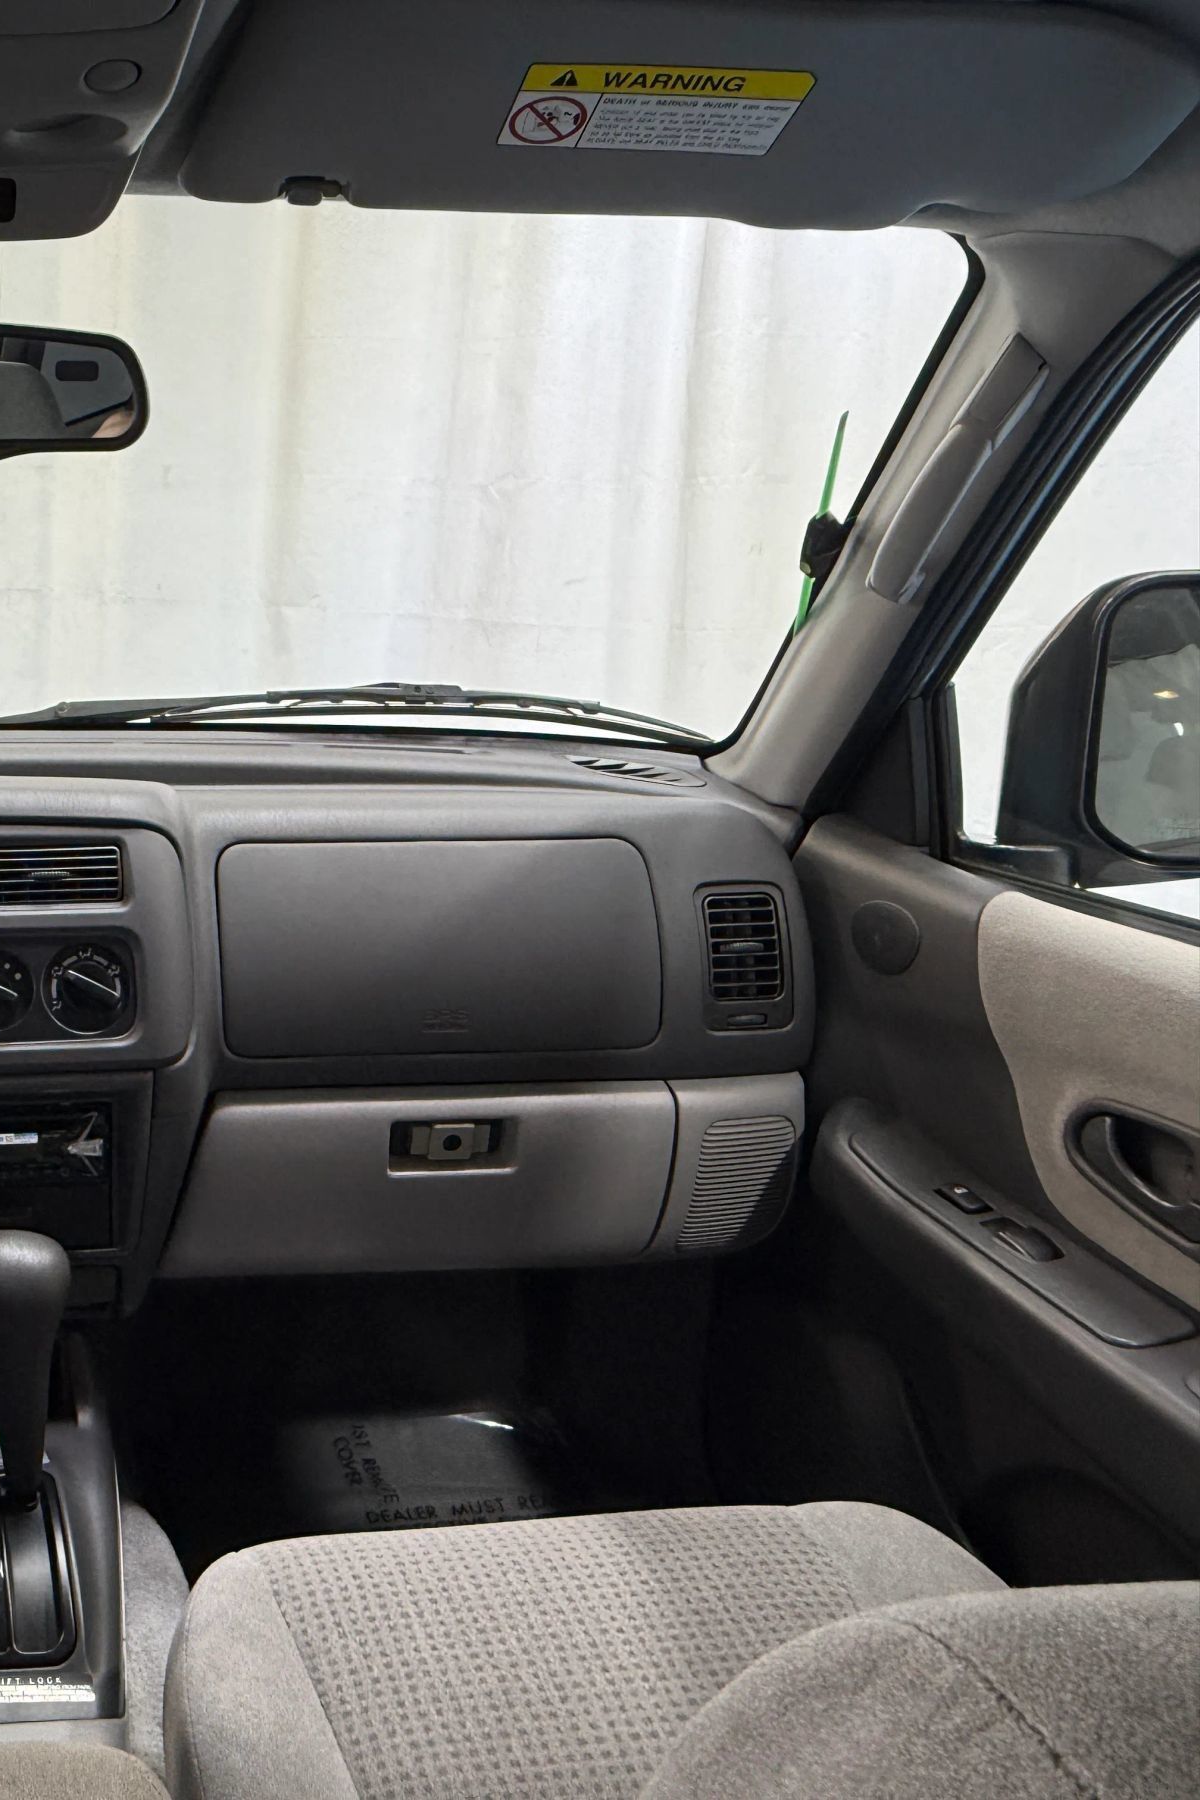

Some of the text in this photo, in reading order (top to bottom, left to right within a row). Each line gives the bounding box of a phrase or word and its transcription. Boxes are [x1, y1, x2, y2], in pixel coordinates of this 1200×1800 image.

[603, 71, 747, 92] WARNING
[366, 1505, 438, 1525] DEALER
[451, 1497, 505, 1517] MUST
[29, 1676, 62, 1685] LOCK
